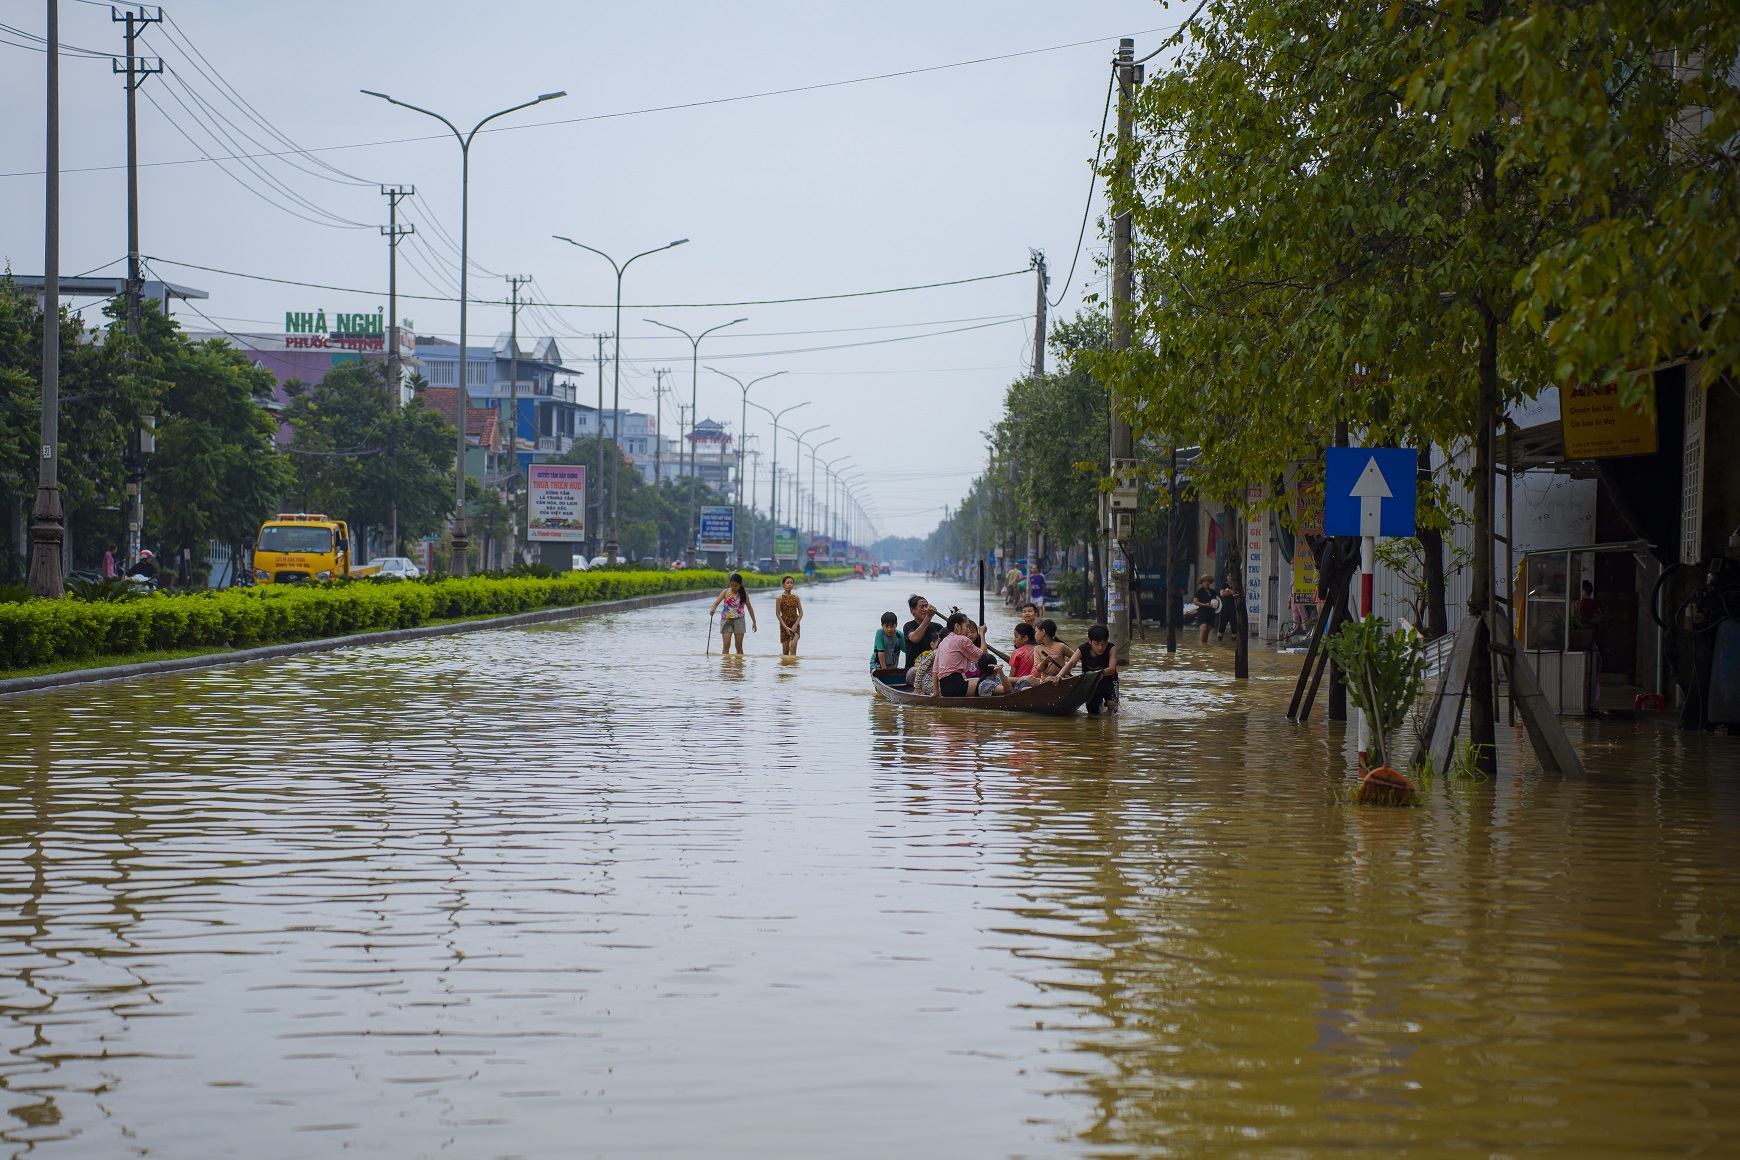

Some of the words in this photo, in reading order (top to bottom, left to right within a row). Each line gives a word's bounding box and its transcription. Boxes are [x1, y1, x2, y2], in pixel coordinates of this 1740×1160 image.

[286, 308, 328, 333] NHÀ
[336, 306, 384, 334] NGHỈ
[285, 335, 333, 349] PHƯỚC
[337, 337, 384, 352] THỊNH
[1569, 406, 1590, 416] Chuyên
[1594, 418, 1602, 426] Xe
[537, 470, 550, 478] QUYẾT
[550, 471, 558, 479] TÂM
[567, 472, 578, 480] DỰNG
[533, 479, 550, 489] THỪA
[550, 480, 568, 489] THIÊN
[569, 480, 582, 490] HUẾ
